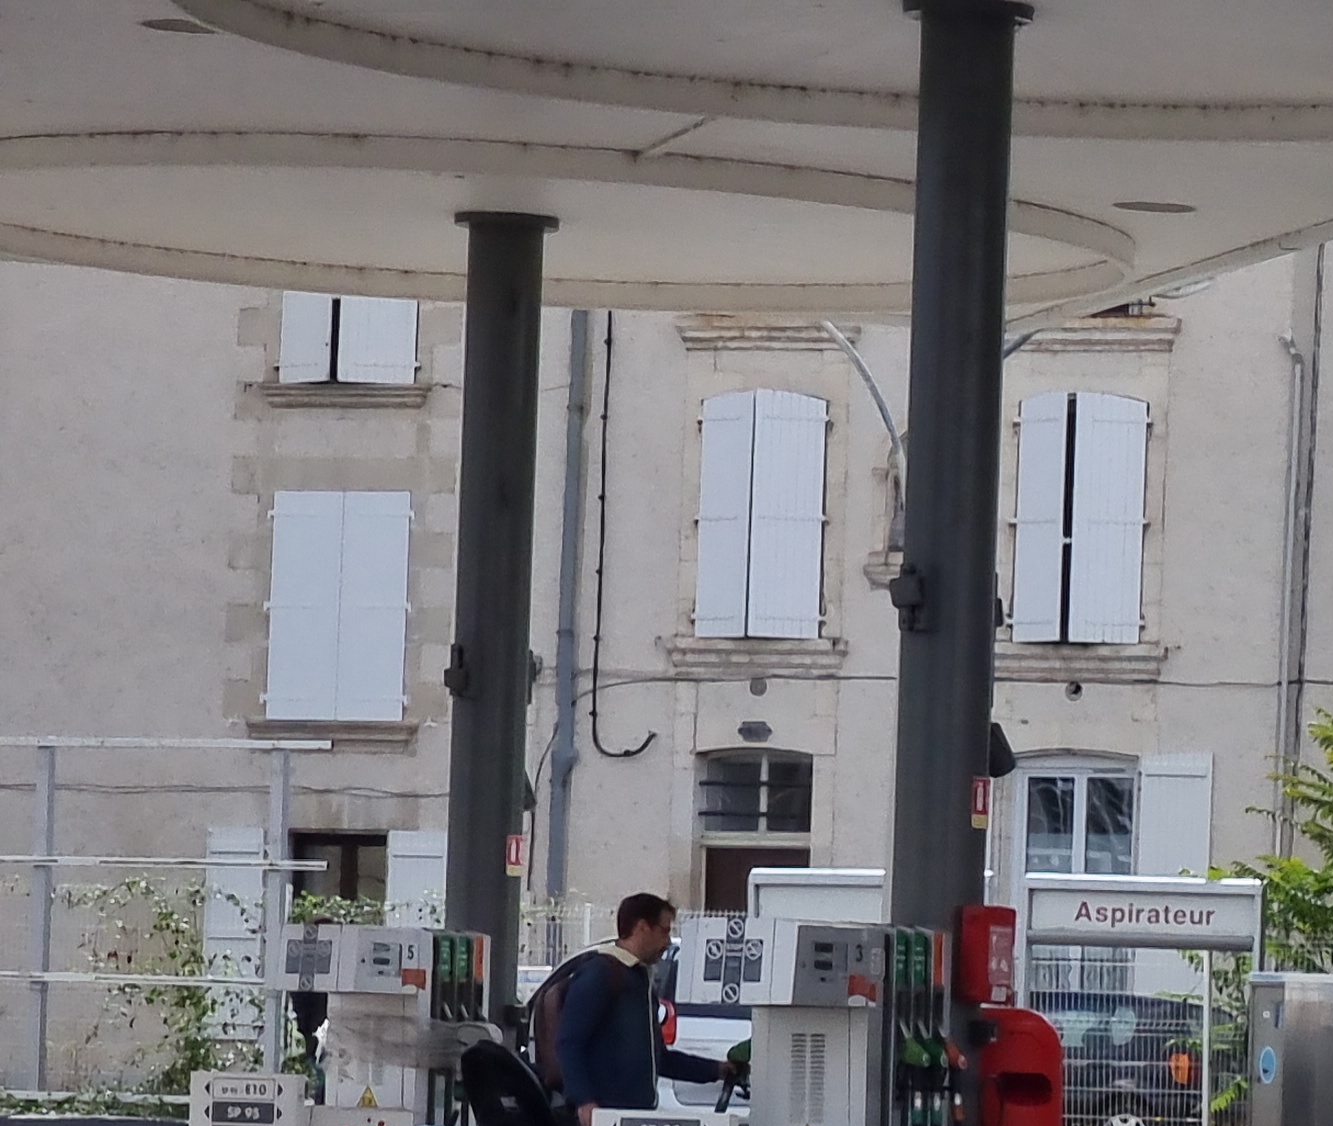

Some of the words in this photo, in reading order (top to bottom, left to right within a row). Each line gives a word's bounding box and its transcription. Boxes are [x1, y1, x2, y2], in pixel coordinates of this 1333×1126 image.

[1074, 900, 1216, 928] Aspirateur
[407, 944, 414, 960] 5
[227, 1107, 241, 1118] SP
[244, 1107, 260, 1119] 95
